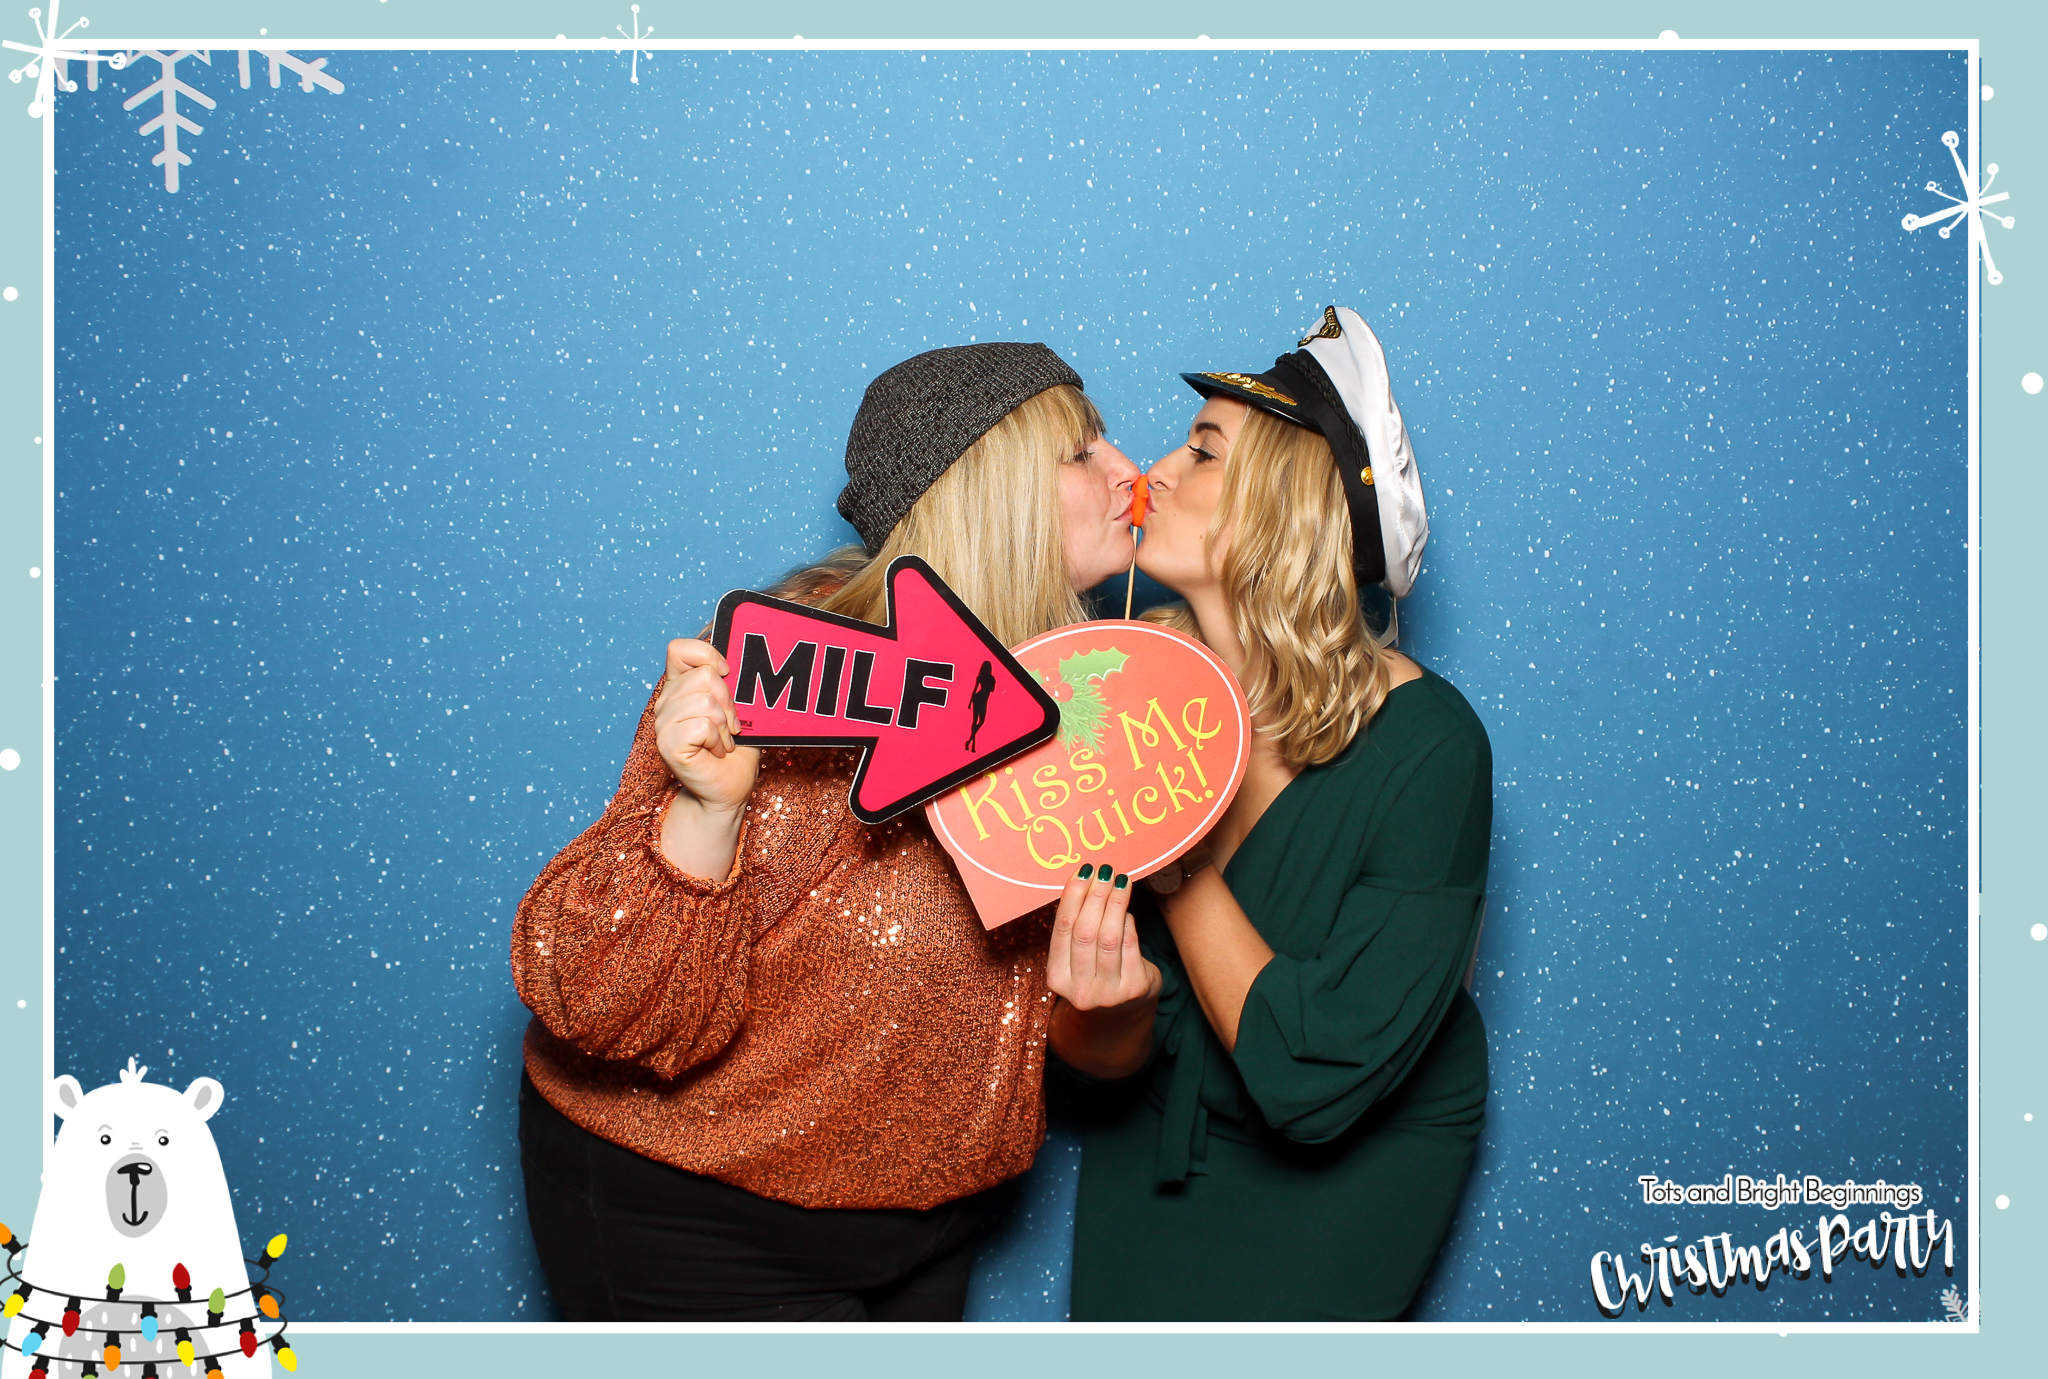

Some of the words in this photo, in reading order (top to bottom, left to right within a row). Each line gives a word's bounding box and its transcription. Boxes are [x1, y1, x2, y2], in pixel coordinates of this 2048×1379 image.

[734, 632, 955, 730] MILF
[959, 748, 1108, 842] Kiss
[1116, 696, 1222, 771] Me
[1025, 747, 1215, 870] Quick!
